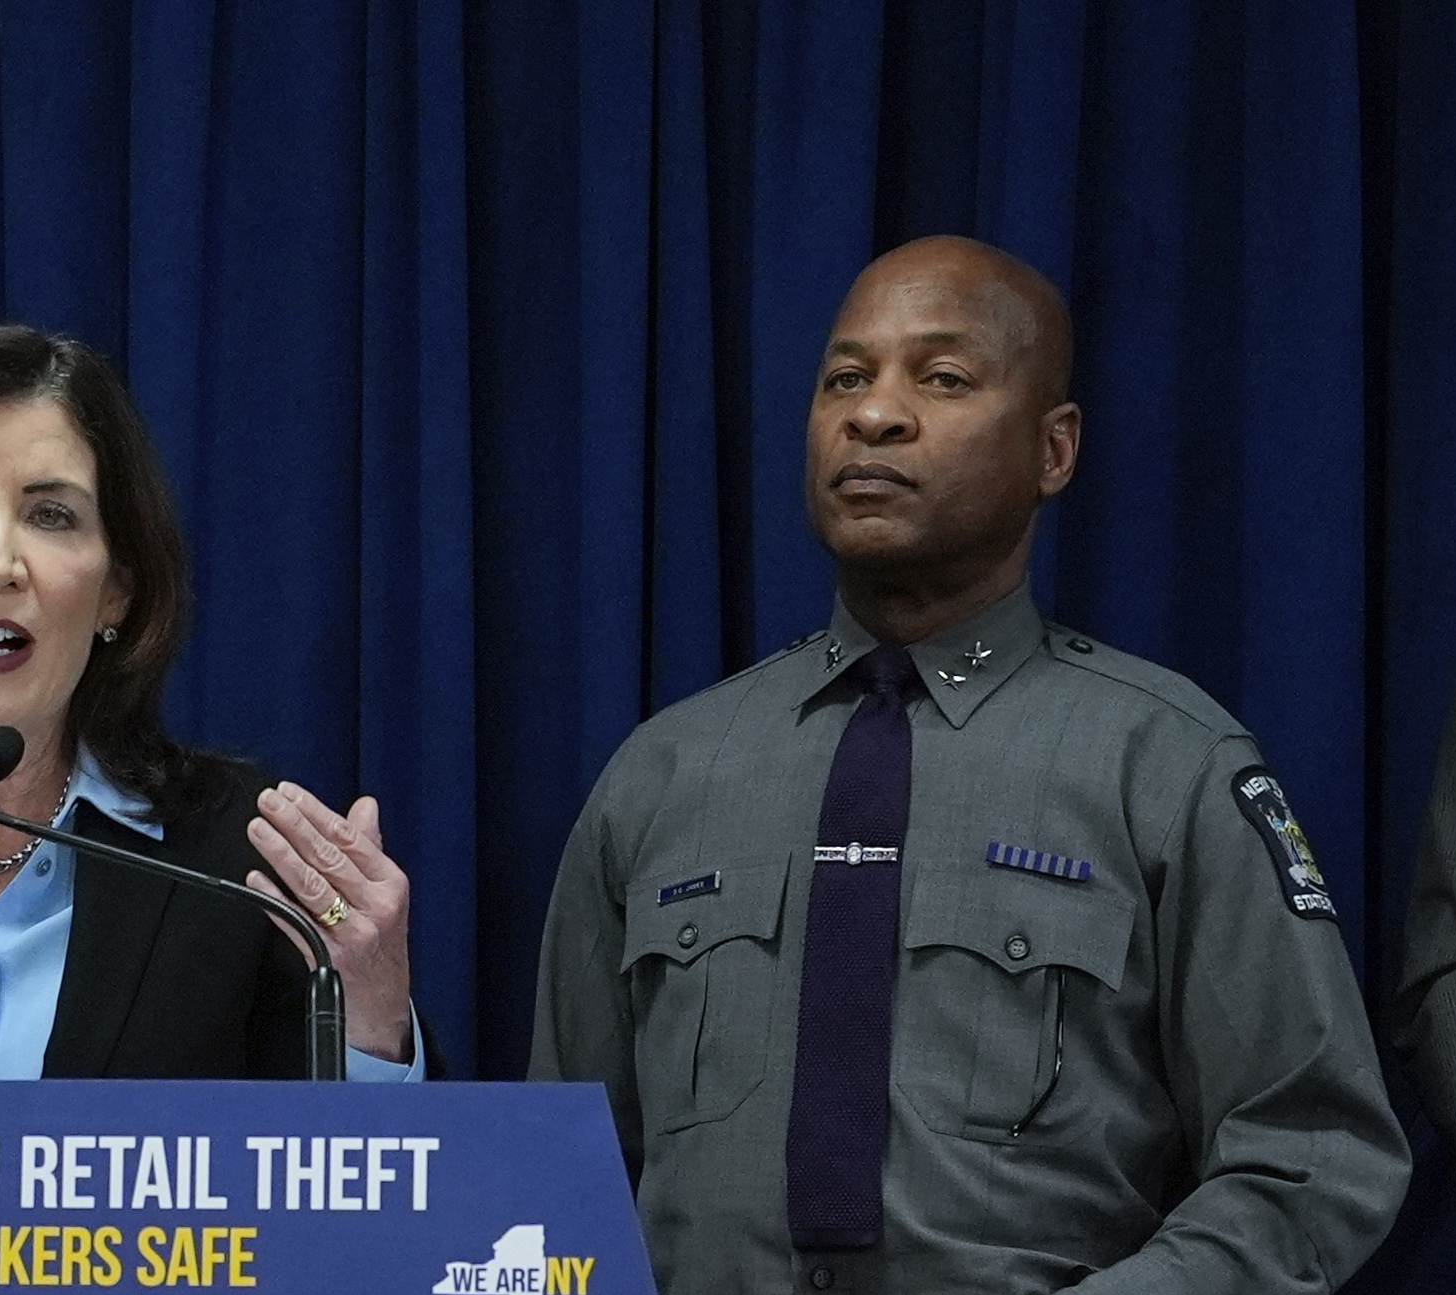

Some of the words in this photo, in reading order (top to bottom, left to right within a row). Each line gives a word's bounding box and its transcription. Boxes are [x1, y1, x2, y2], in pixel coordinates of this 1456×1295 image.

[20, 1135, 228, 1210] RETAIL
[246, 1136, 440, 1211] THEFT
[136, 1226, 258, 1287] SAFE
[452, 1268, 487, 1292] WE
[496, 1268, 540, 1293] ARE
[546, 1257, 595, 1295] NY
